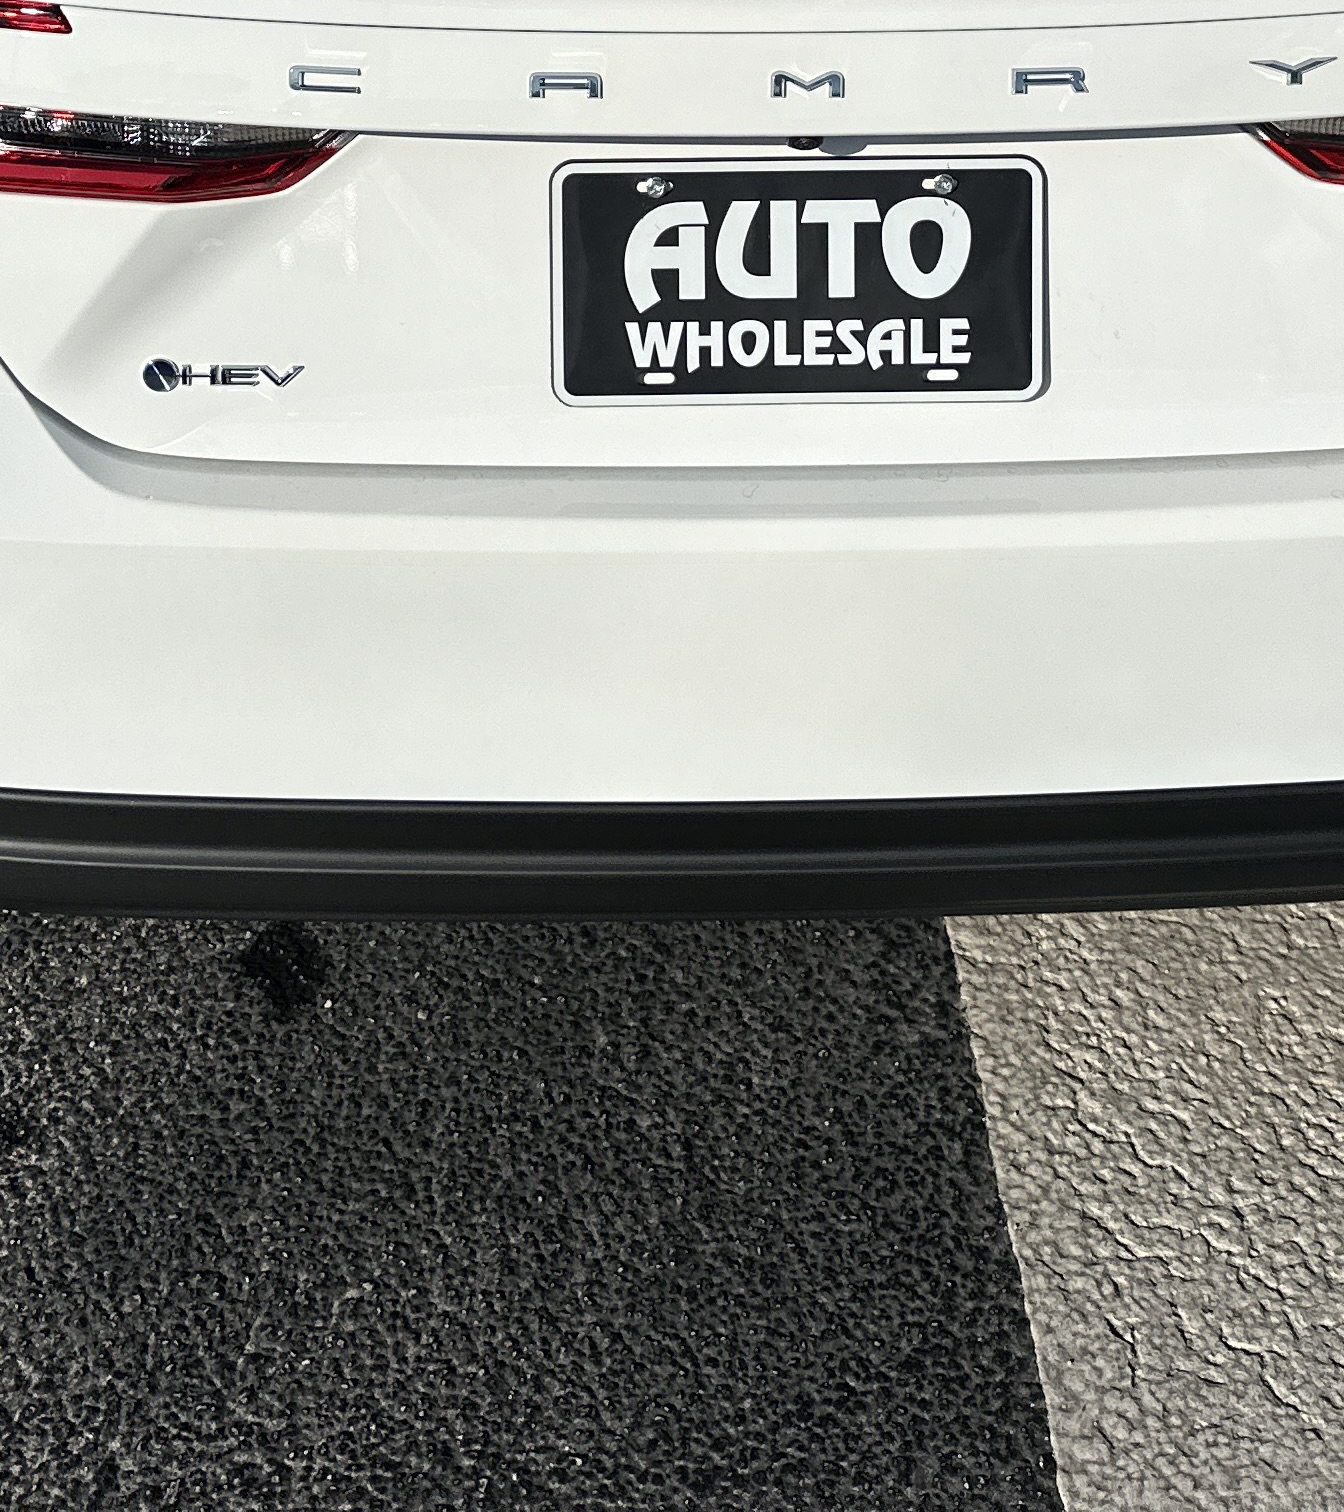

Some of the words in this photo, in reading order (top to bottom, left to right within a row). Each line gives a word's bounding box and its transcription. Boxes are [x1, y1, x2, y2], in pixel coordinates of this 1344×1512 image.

[288, 54, 1340, 102] CAMRY
[623, 195, 972, 314] AUTO
[623, 317, 972, 374] WHOLESALE
[182, 364, 305, 388] HEV
